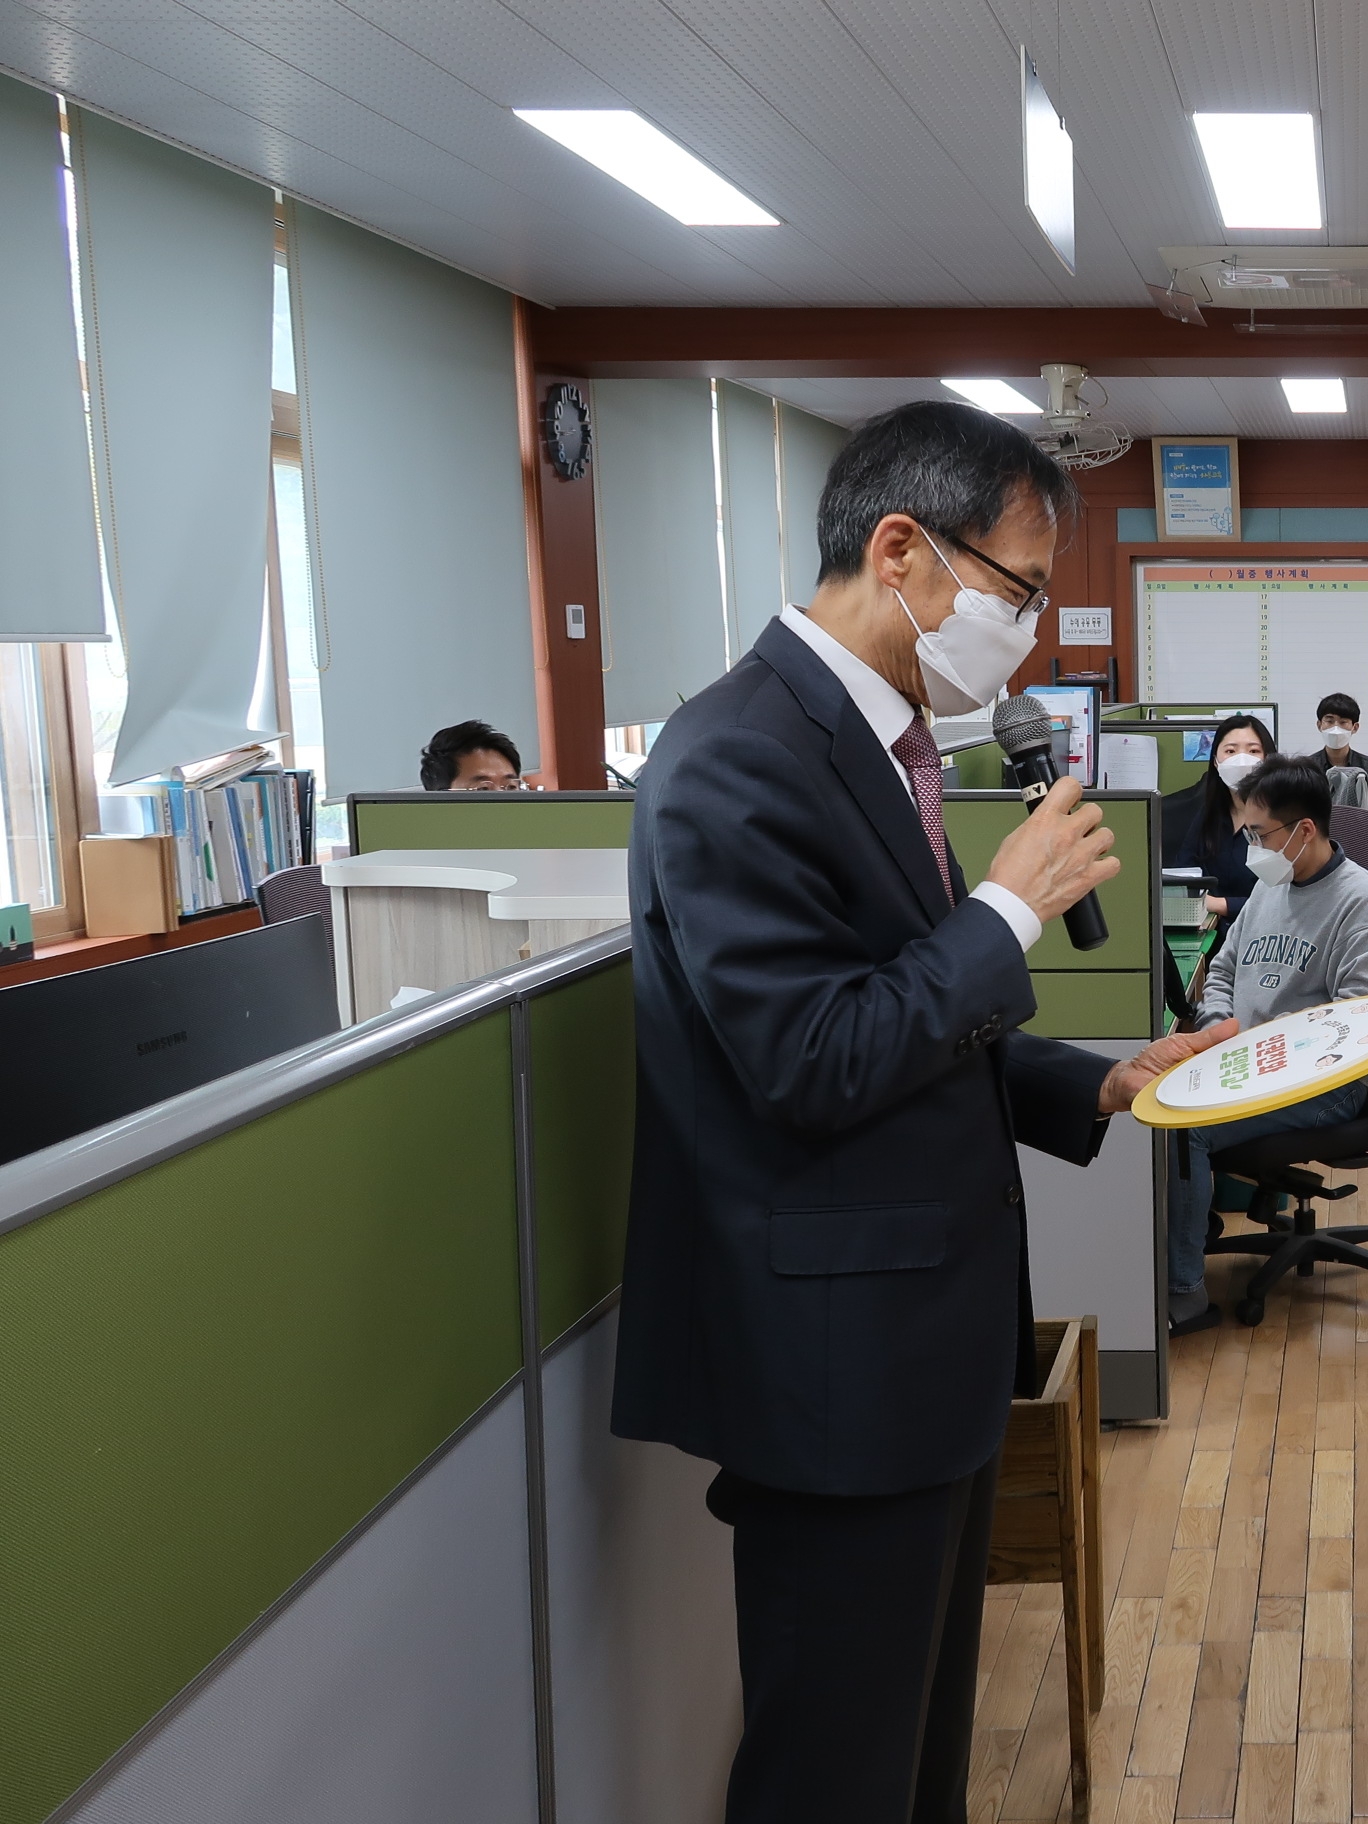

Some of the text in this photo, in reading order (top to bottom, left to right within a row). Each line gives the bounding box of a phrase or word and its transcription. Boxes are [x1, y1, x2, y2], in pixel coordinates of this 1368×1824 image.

[136, 1030, 188, 1056] SAMSUNG
[1256, 1033, 1289, 1076] 인권친화
[1219, 1046, 1249, 1090] 모델학교
